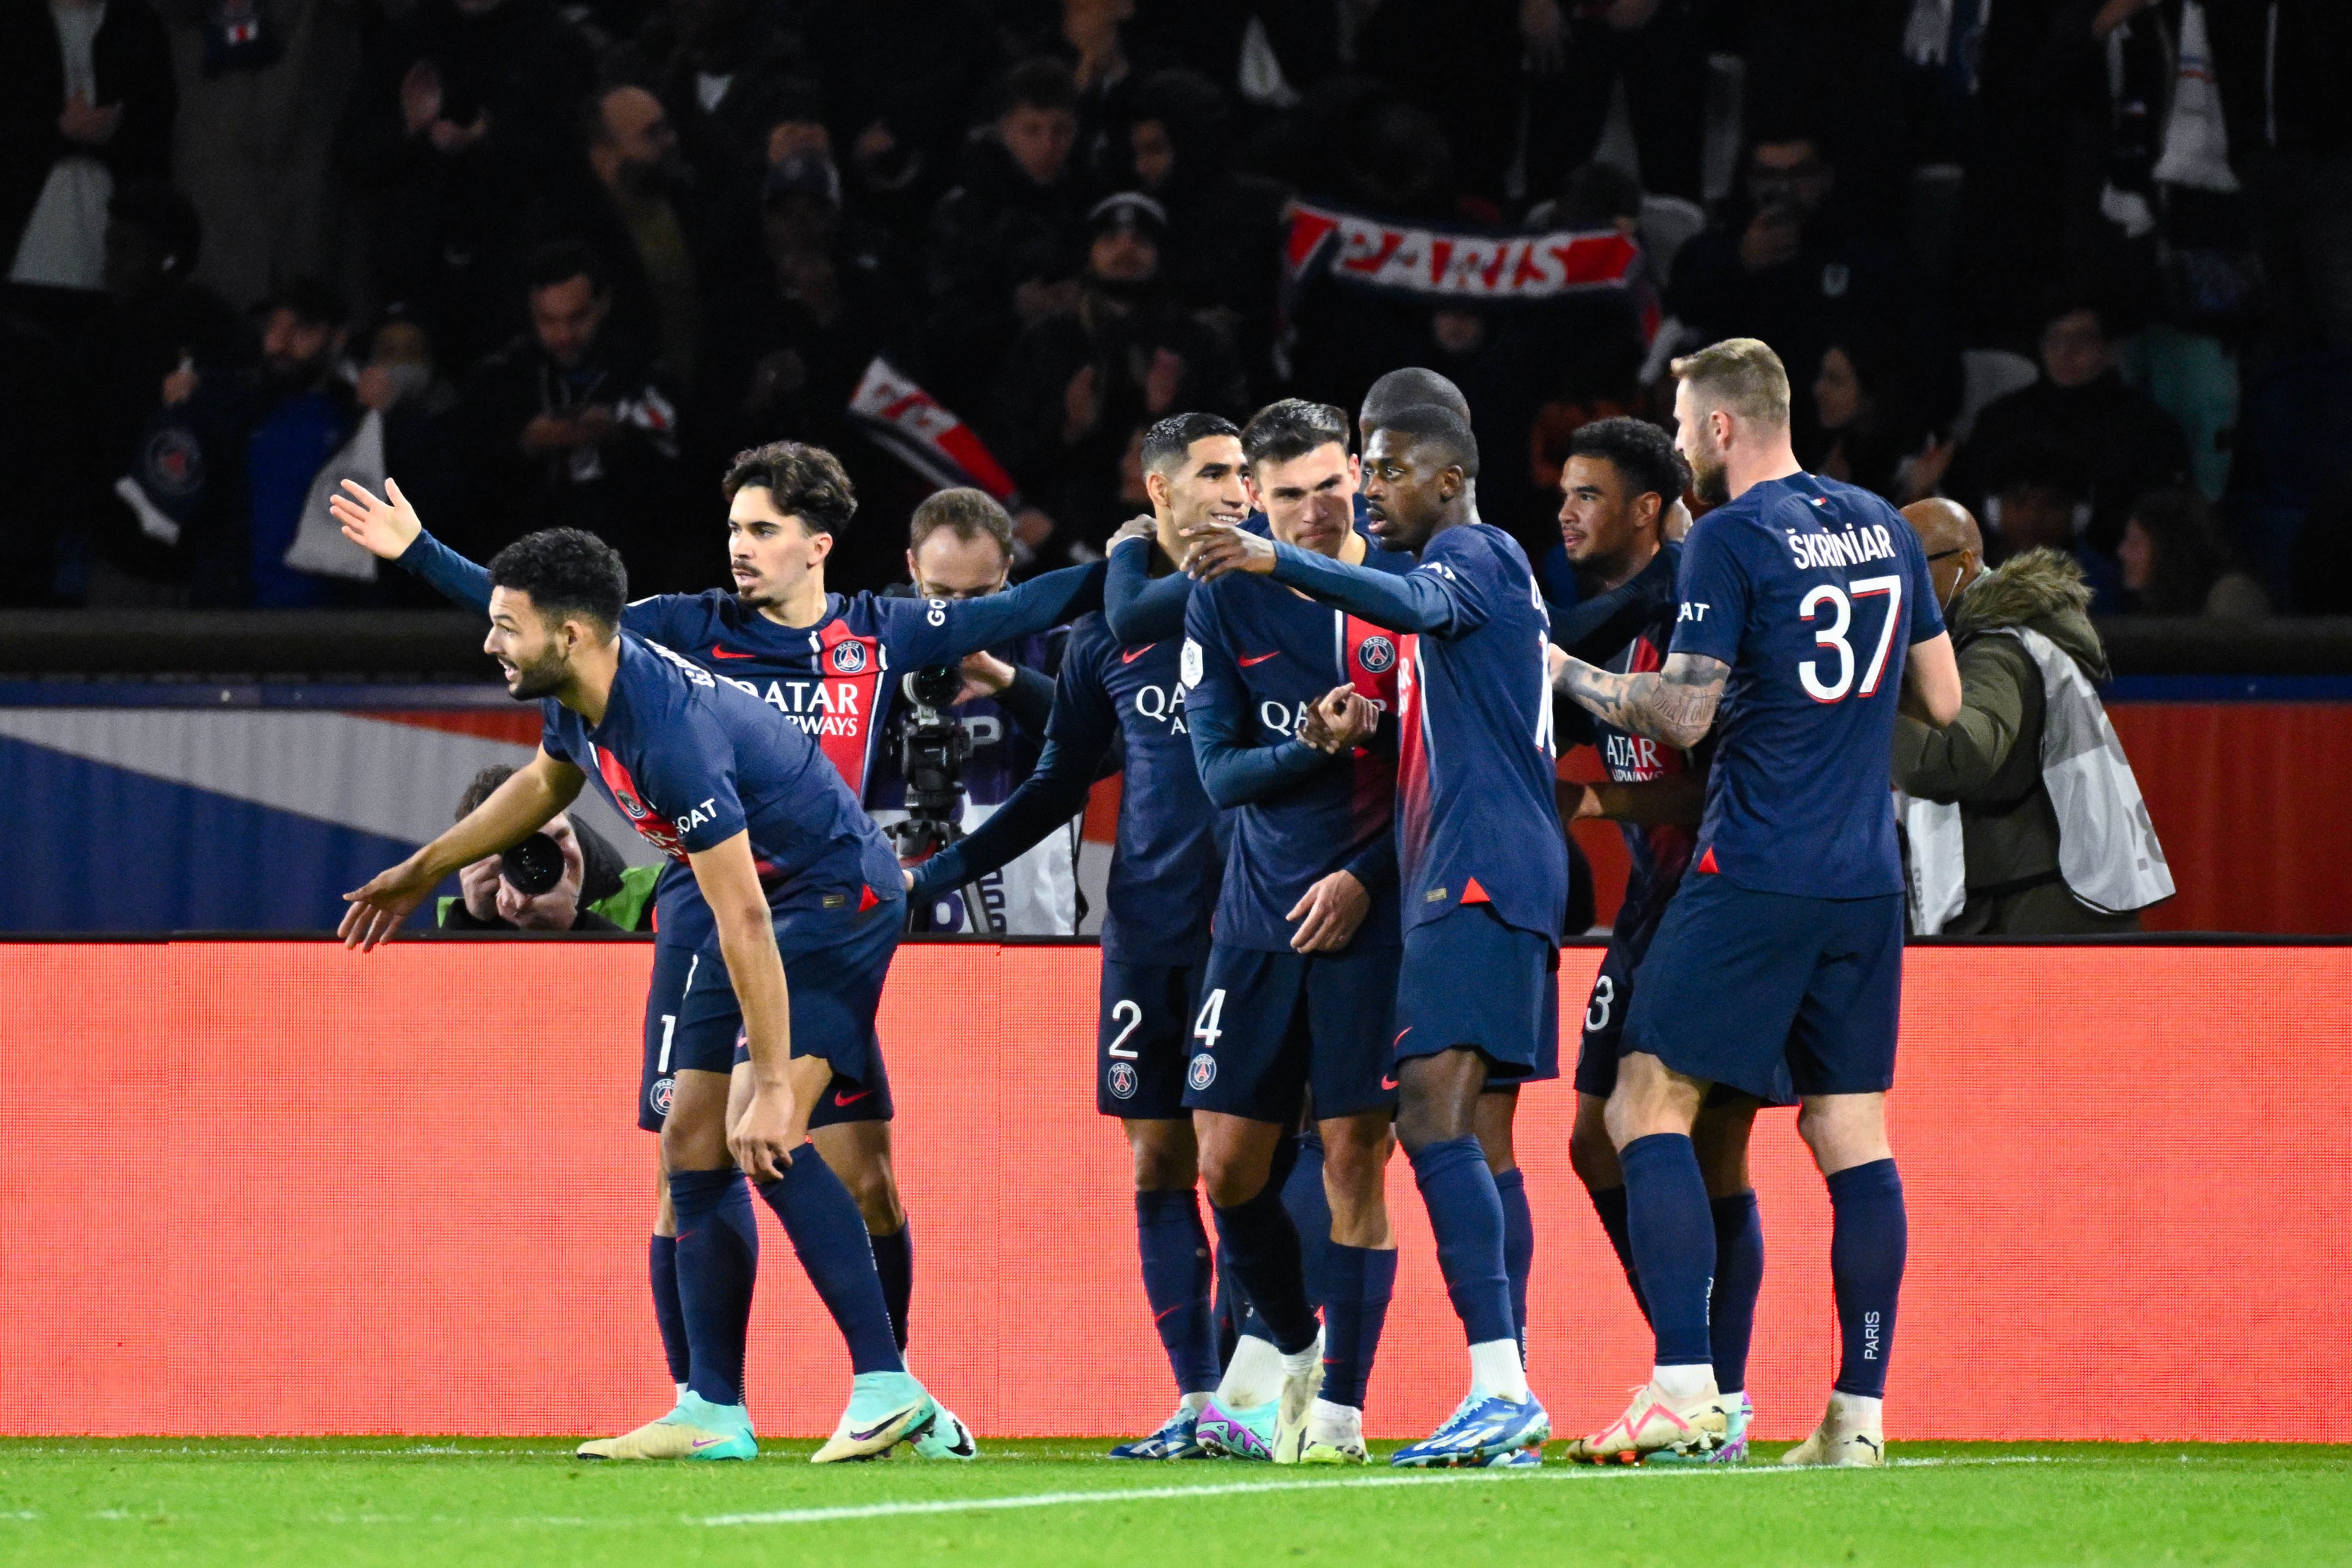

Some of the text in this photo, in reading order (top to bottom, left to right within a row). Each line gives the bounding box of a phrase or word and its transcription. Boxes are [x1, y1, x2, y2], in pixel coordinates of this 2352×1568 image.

[1333, 215, 1567, 296] PARIS
[837, 642, 860, 652] PARIS
[1363, 637, 1388, 649] PARIS
[1799, 575, 1902, 704] 37
[657, 1014, 677, 1077] 1
[1109, 1000, 1142, 1060] 2
[1194, 989, 1227, 1047] 4
[1112, 1064, 1133, 1074] PARIS
[1864, 1311, 1880, 1360] PARIS
